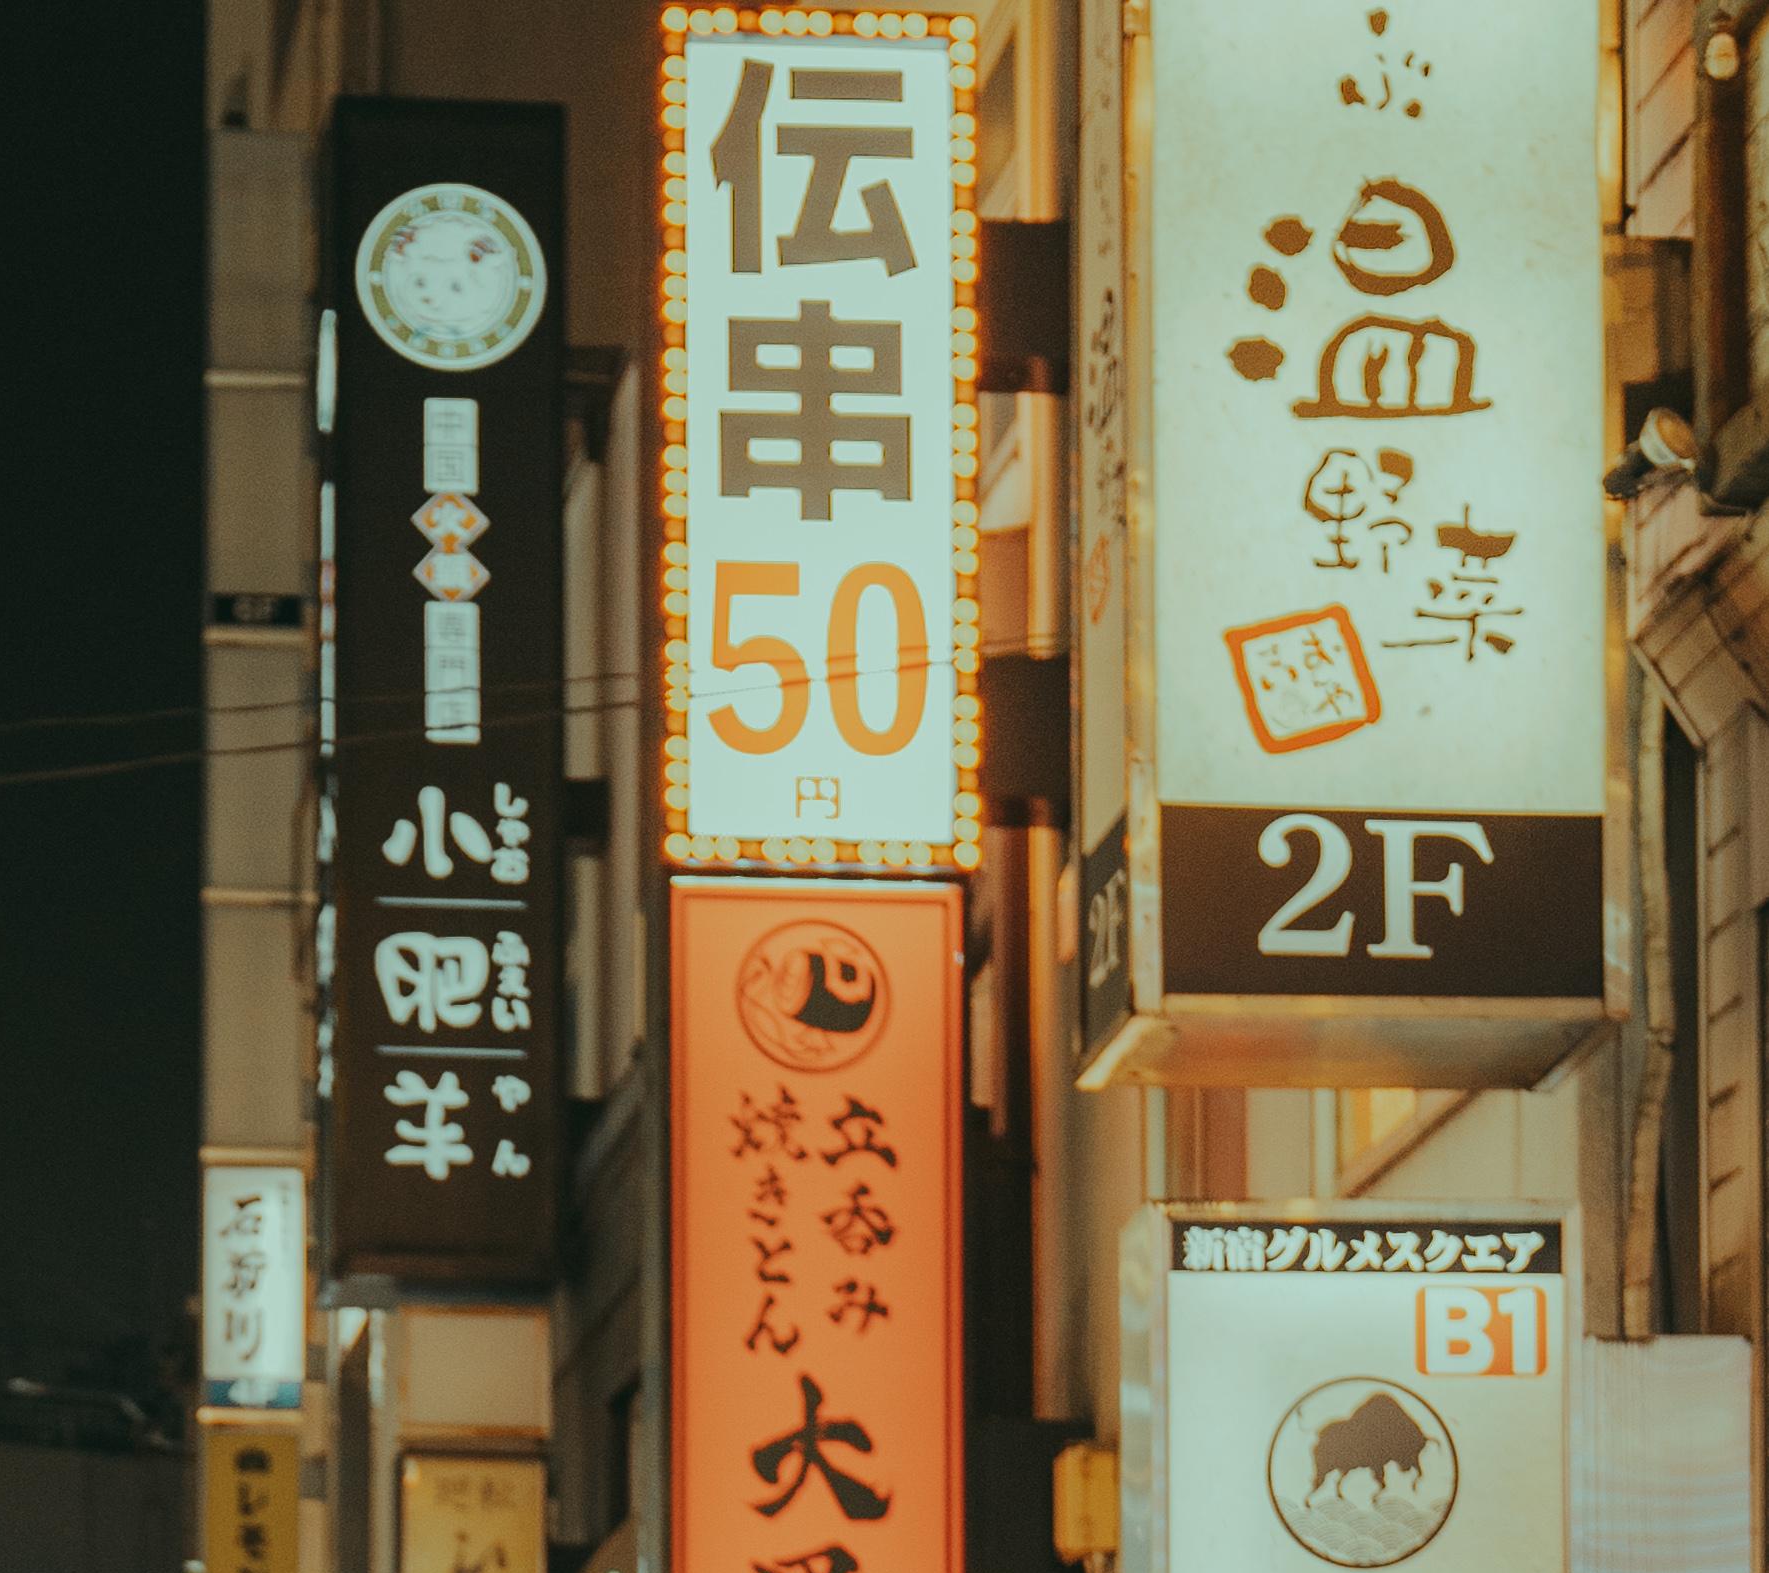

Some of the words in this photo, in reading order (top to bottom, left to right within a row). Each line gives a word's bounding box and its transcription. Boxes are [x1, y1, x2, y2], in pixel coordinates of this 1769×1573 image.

[709, 58, 919, 523] 伝串
[707, 560, 929, 757] 50
[794, 775, 842, 821] 円
[1256, 812, 1496, 960] 2F
[374, 785, 490, 1181] 小肥羊
[1182, 1225, 1547, 1273] 新宿グルメスクエア
[1425, 1287, 1539, 1377] B1
